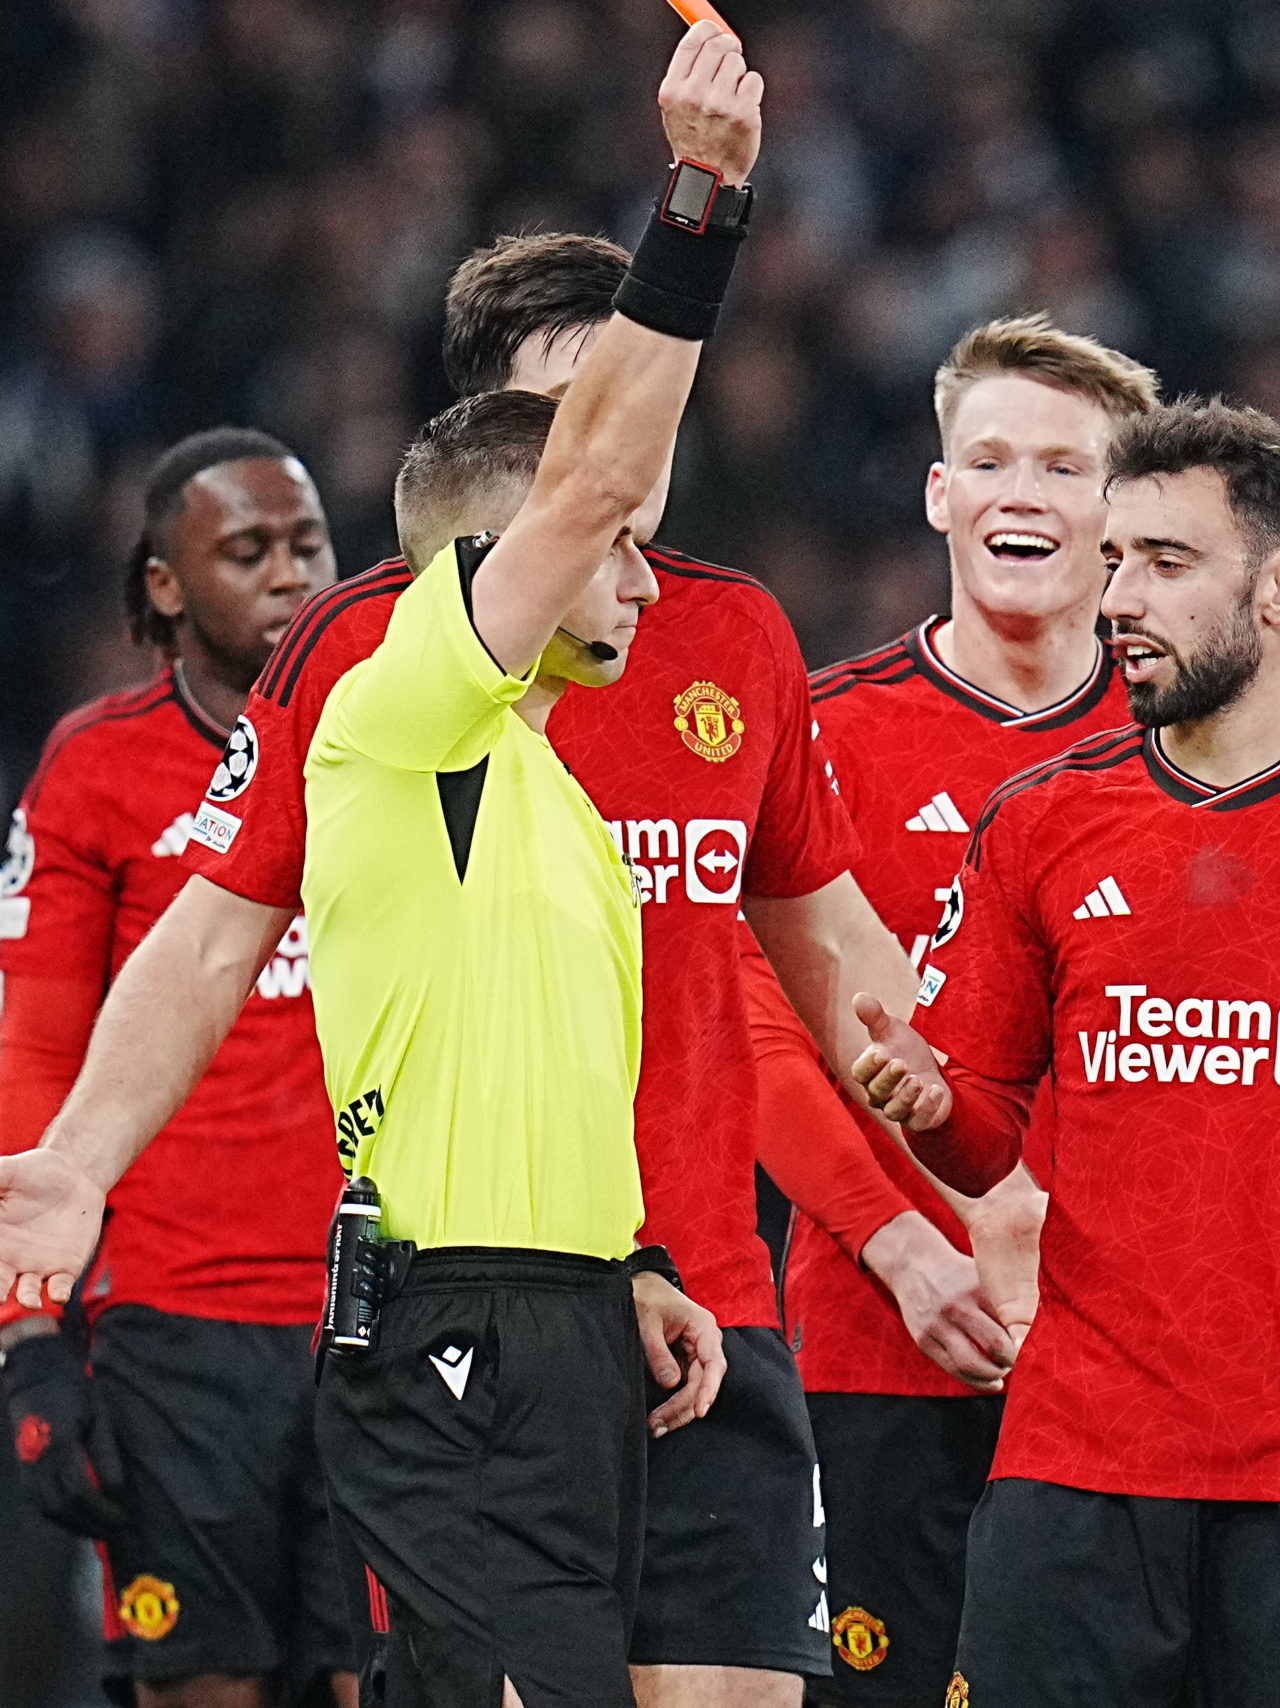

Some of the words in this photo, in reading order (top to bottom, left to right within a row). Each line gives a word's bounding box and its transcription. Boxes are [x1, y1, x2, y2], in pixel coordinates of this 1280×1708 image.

[680, 687, 735, 714] MANCHESTER
[694, 741, 733, 757] UNITED
[1105, 984, 1272, 1041] Team
[1078, 1029, 1270, 1086] Viewer
